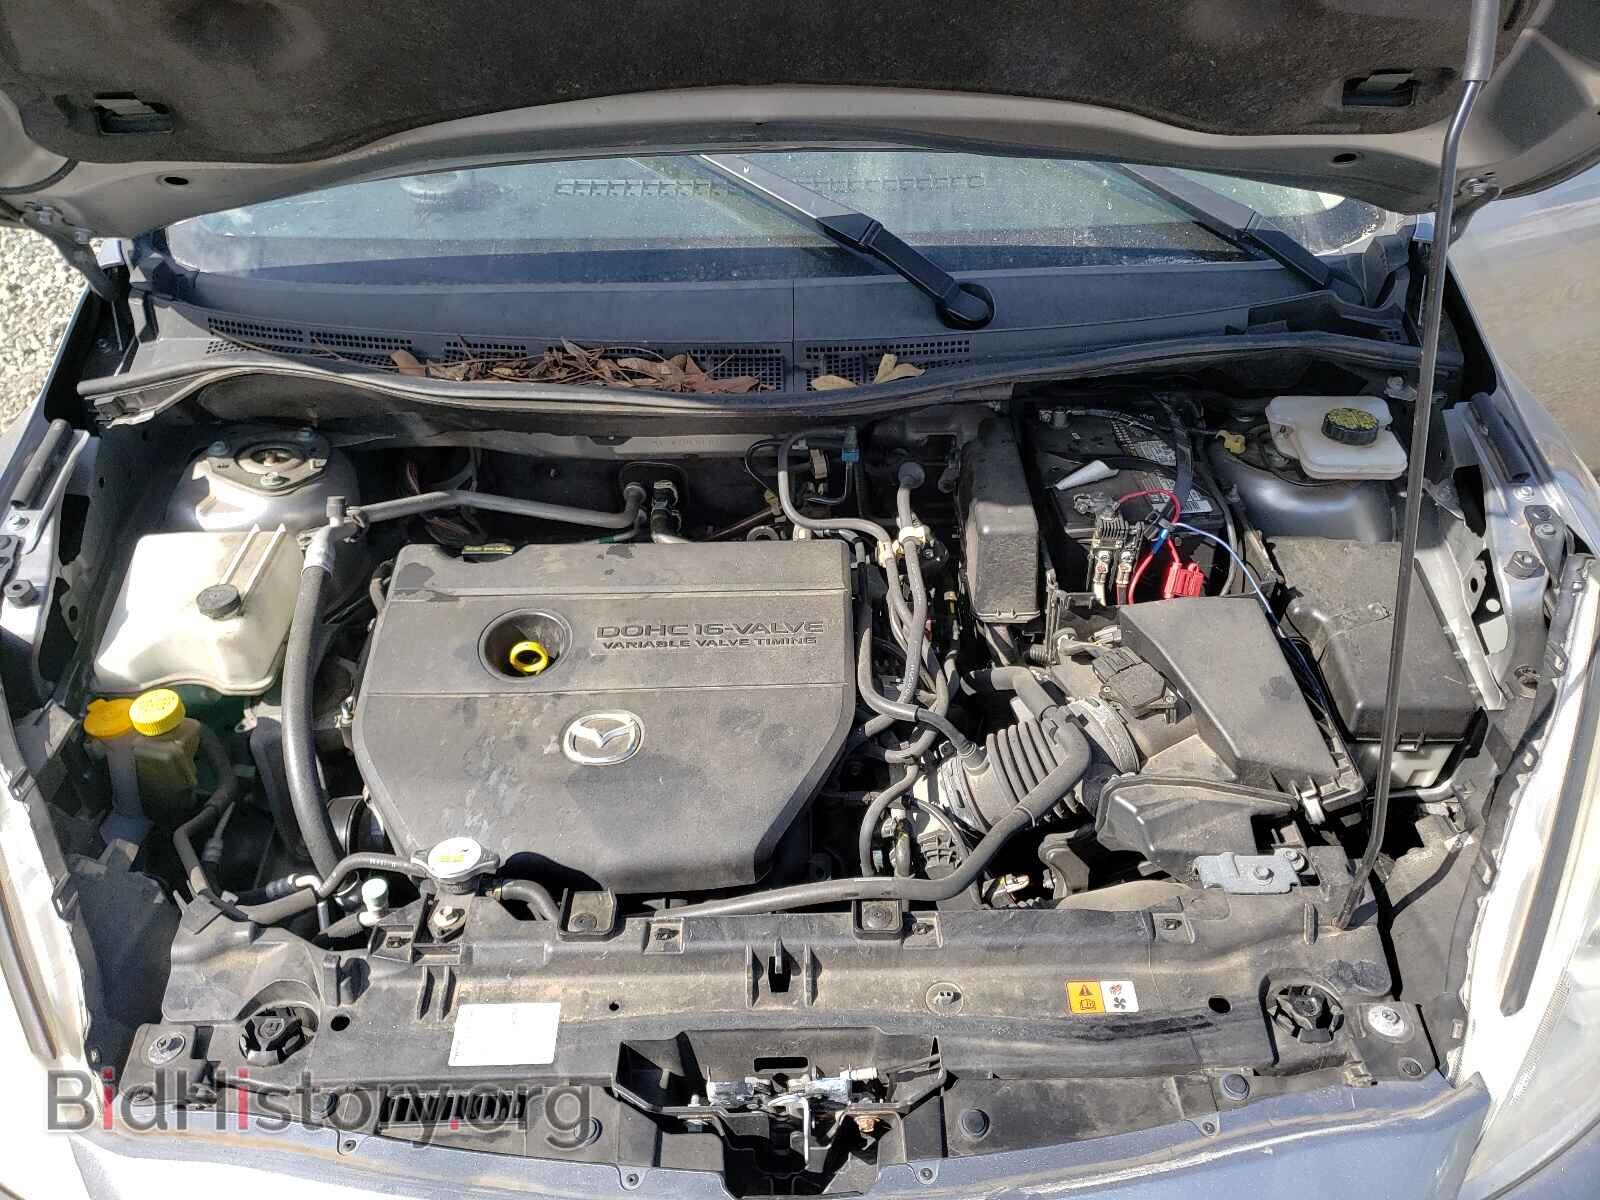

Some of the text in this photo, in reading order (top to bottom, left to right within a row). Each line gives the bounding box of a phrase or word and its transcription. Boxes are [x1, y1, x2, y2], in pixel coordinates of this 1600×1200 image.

[598, 621, 823, 638] DOHC 16-VALVE
[602, 637, 817, 649] VARIABLE VALVE TIMING
